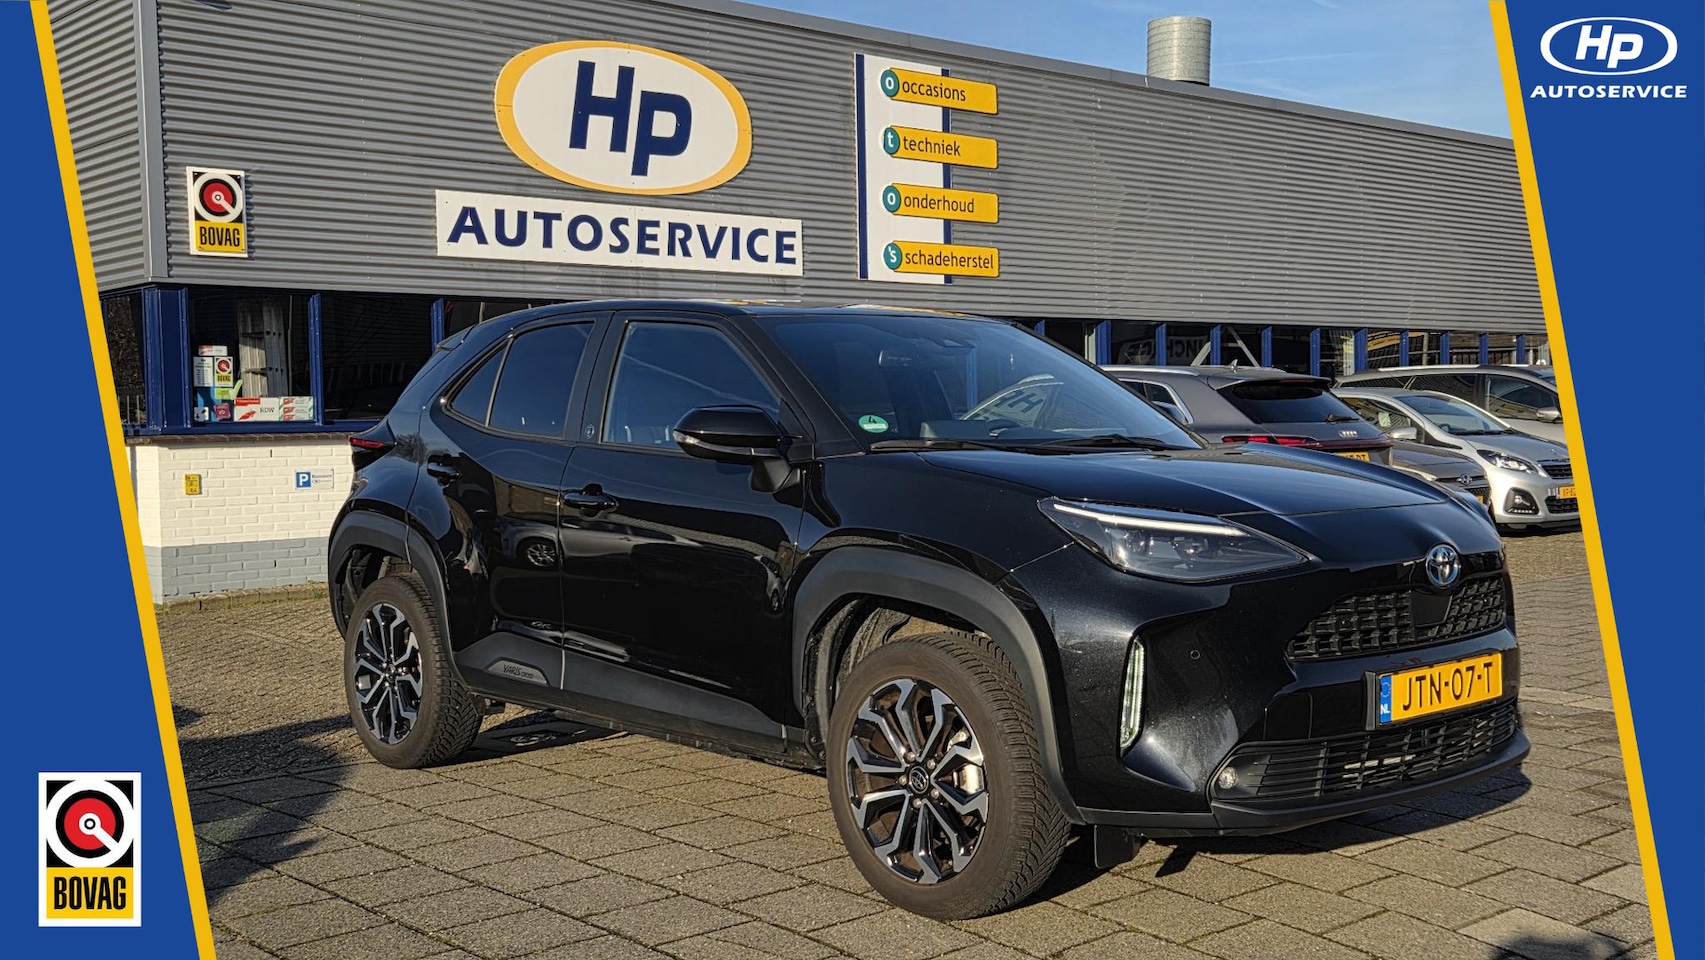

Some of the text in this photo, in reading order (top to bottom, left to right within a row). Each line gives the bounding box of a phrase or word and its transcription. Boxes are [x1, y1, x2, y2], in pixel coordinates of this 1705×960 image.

[902, 81, 967, 102] occasions
[569, 60, 692, 177] Hp
[903, 135, 962, 156] techniek
[904, 193, 975, 213] onderhoud
[199, 226, 241, 247] BOVAG
[447, 206, 797, 265] AUTOSERVICE
[905, 249, 995, 269] schadeherstel
[1402, 661, 1493, 712] JTN-07-T
[1380, 703, 1391, 715] NL
